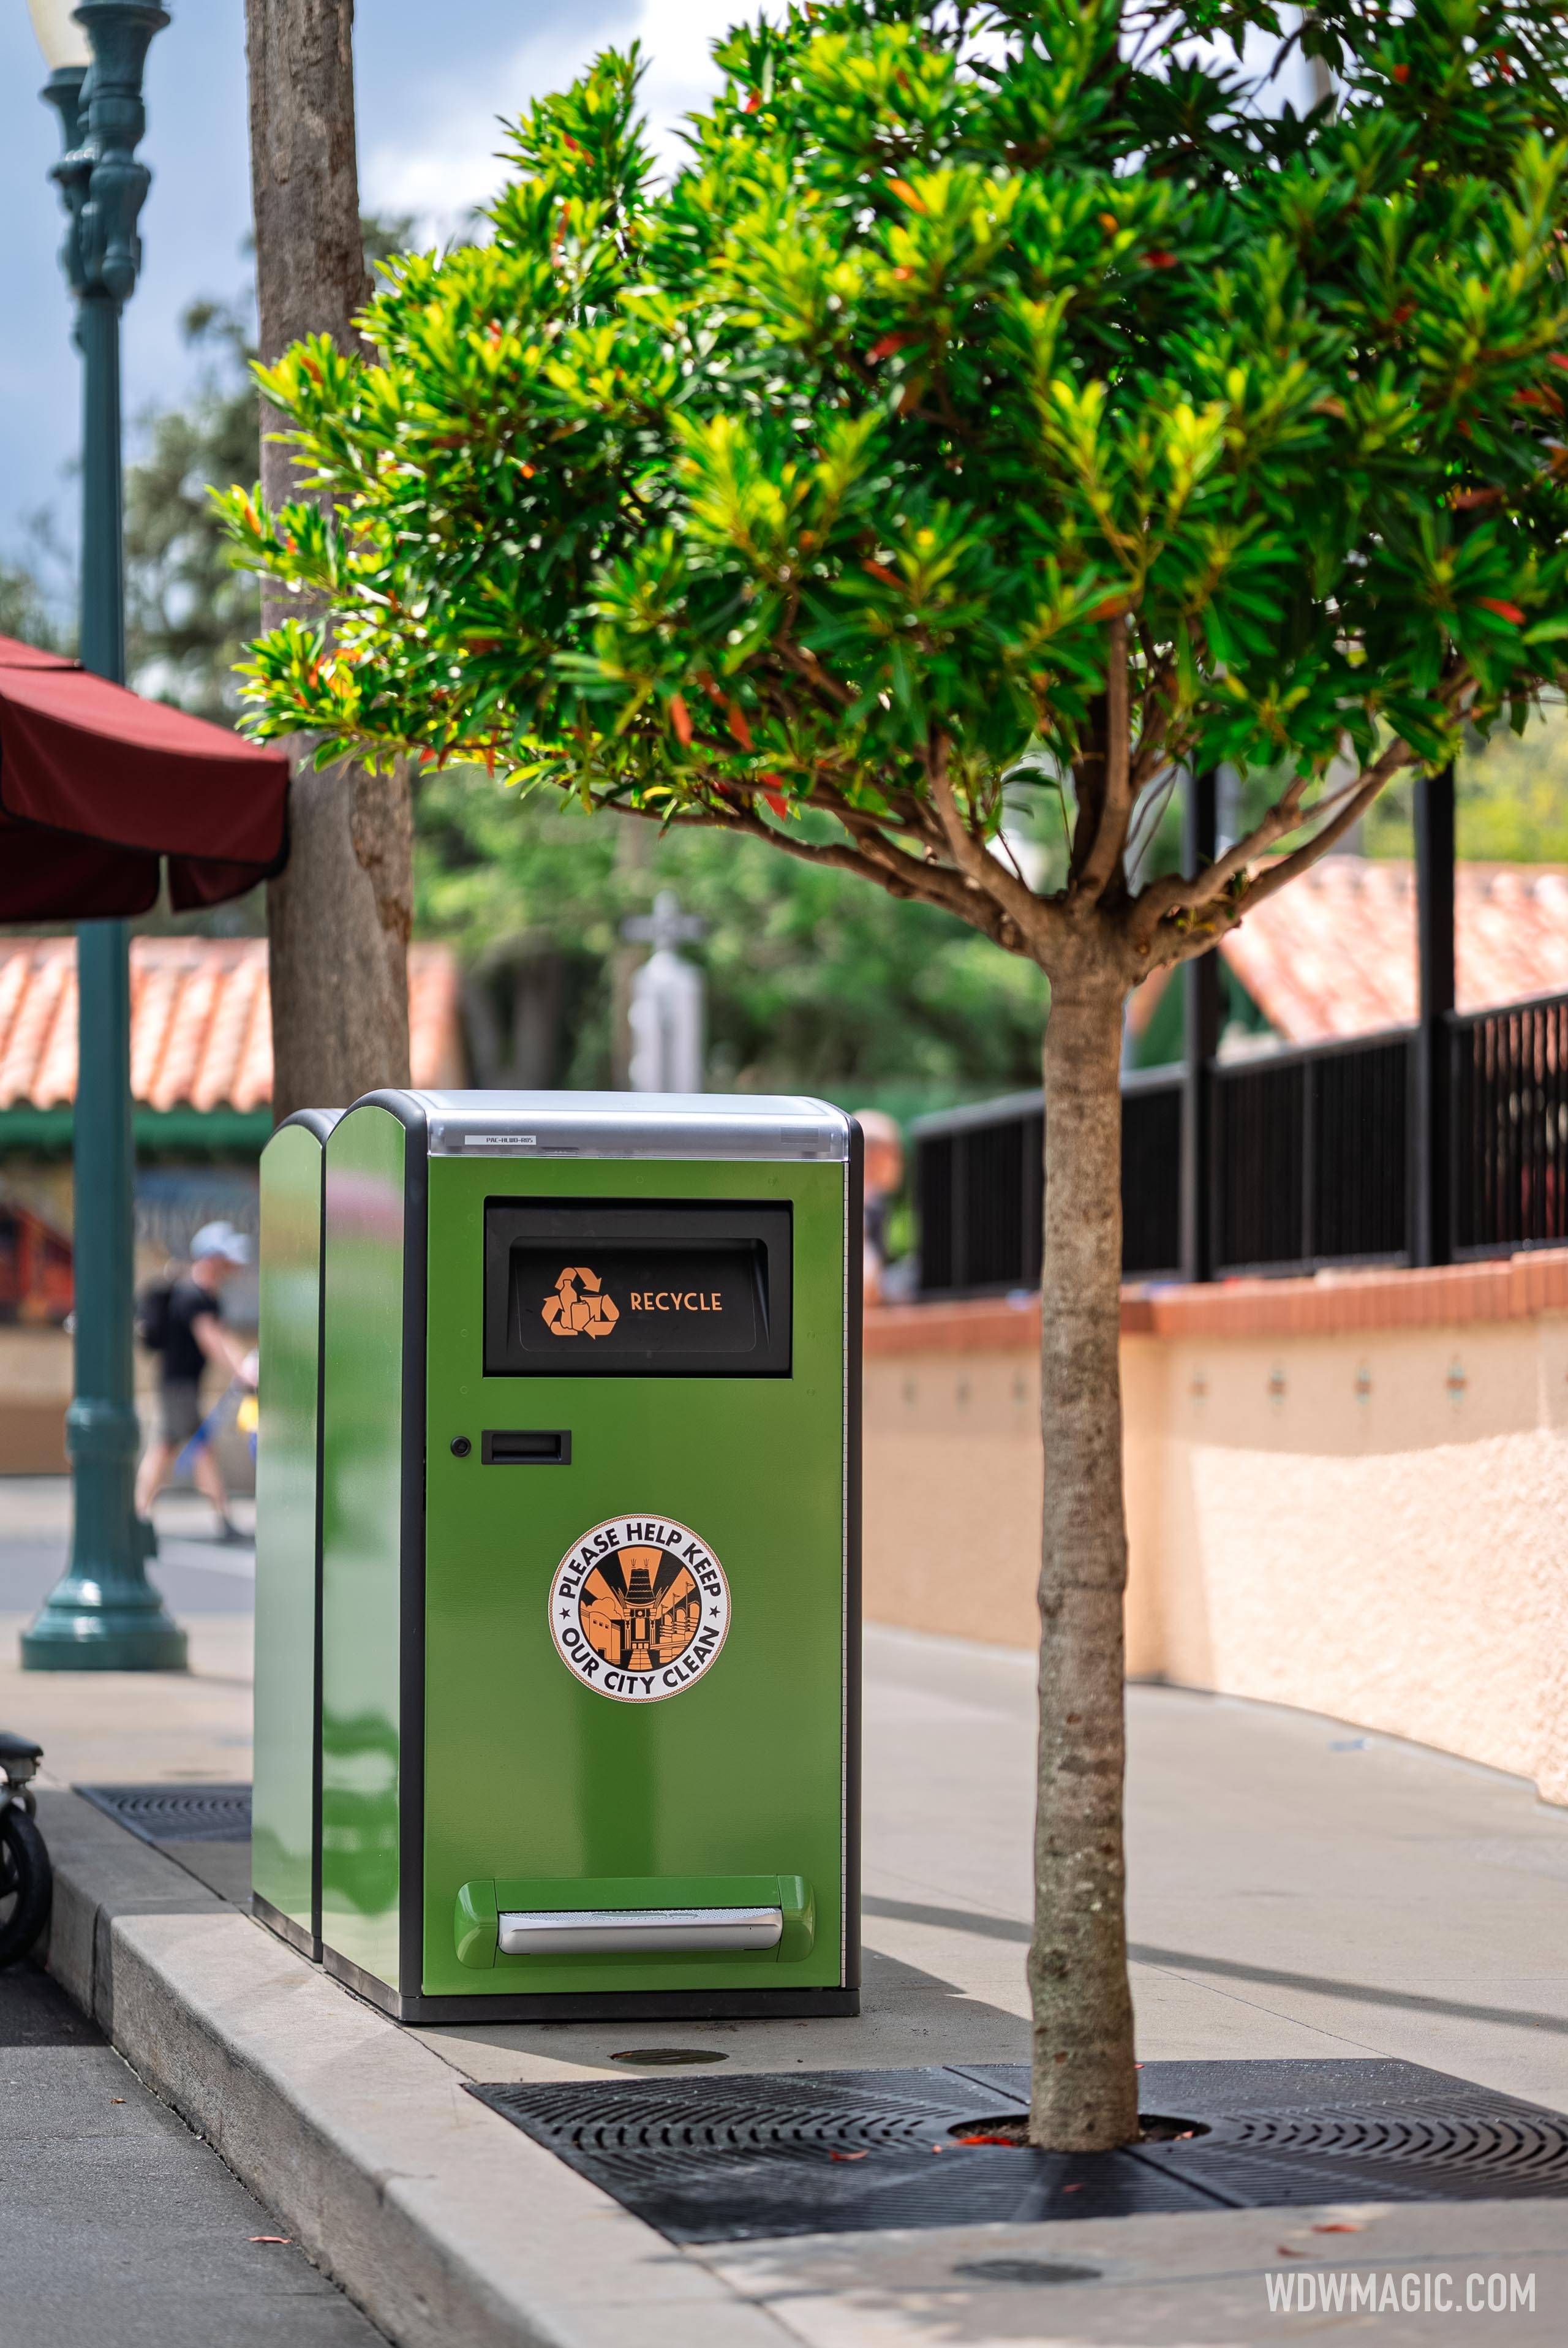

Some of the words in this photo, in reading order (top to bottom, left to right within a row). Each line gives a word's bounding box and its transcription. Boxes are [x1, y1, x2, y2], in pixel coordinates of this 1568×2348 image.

[630, 1293, 722, 1311] RECYCLE
[559, 1528, 620, 1599] PLEASE
[626, 1522, 682, 1547] HELP
[682, 1542, 722, 1597] KEEP
[562, 1628, 600, 1678] OUR
[604, 1671, 655, 1694] CITY
[662, 1625, 720, 1688] CLEAN
